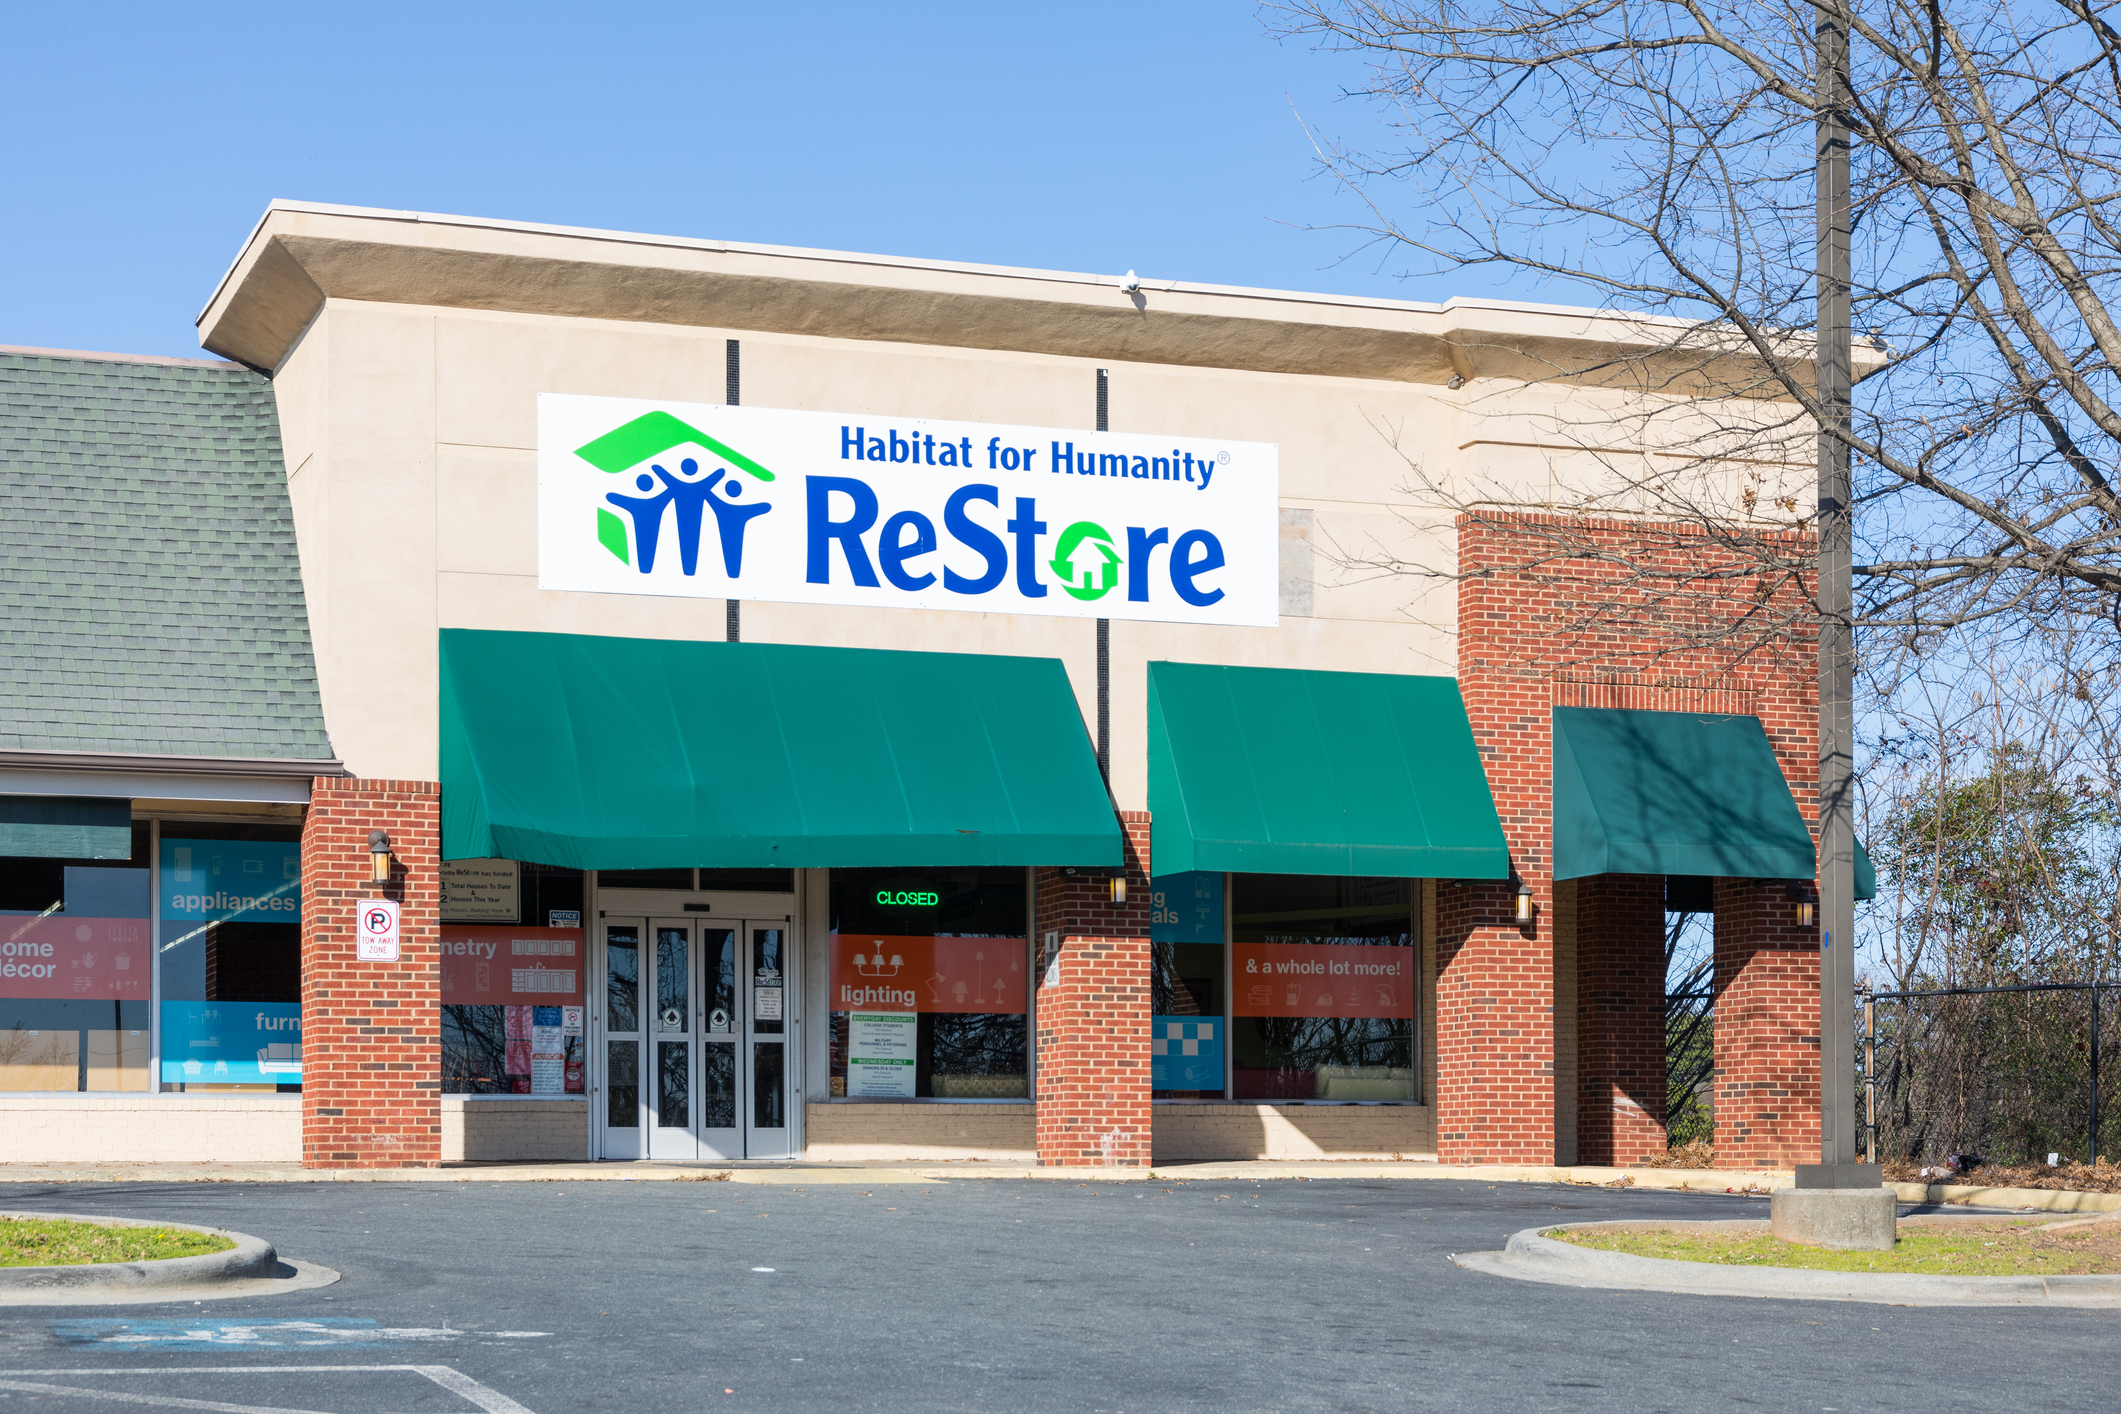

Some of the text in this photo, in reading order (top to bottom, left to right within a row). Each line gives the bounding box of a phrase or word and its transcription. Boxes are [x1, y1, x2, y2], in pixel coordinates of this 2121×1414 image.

[841, 425, 973, 469] Habitat
[987, 437, 1037, 472] for
[806, 475, 1226, 607] ReStore
[172, 891, 296, 913] appliances
[440, 895, 448, 903] 2
[876, 891, 939, 906] CLOSED
[0, 942, 54, 957] ome
[362, 936, 395, 945] TOW AWAY
[440, 938, 498, 960] netry
[369, 946, 387, 954] ZONE
[0, 958, 57, 978] écor
[1245, 958, 1401, 976] & a whole lot more!
[756, 978, 781, 986] ReStore
[841, 985, 916, 1007] lighting
[255, 1012, 302, 1031] furn
